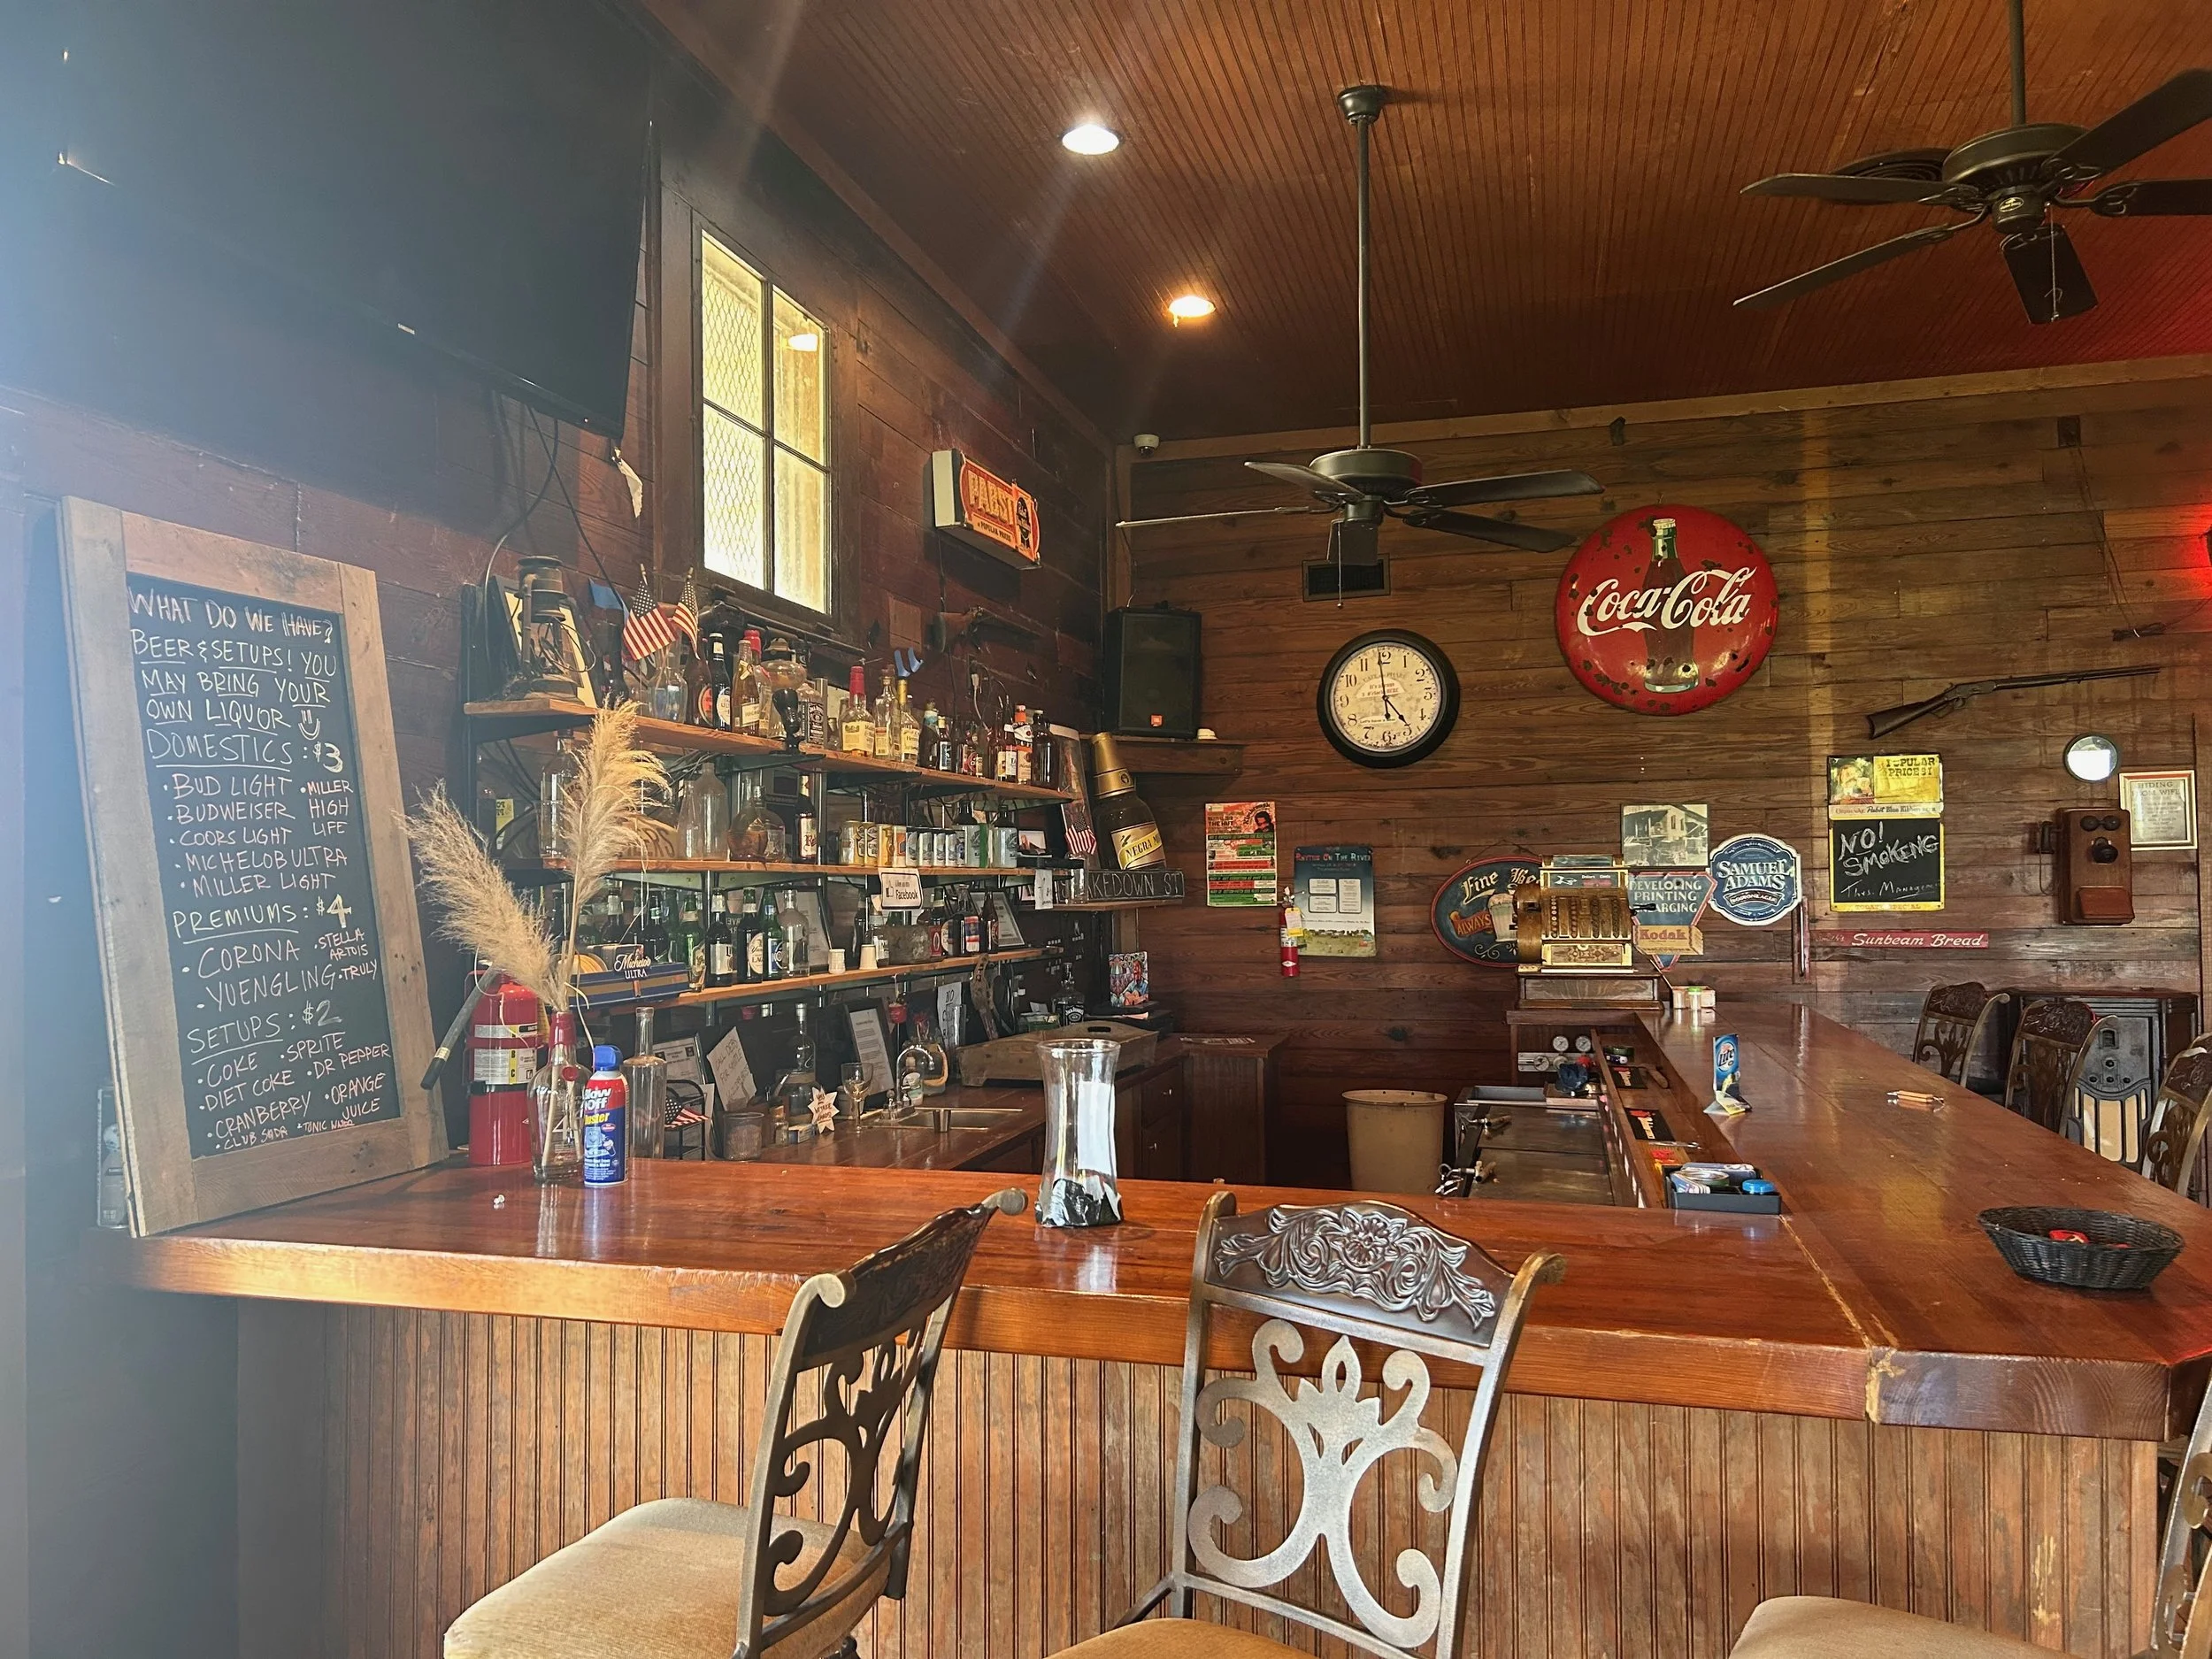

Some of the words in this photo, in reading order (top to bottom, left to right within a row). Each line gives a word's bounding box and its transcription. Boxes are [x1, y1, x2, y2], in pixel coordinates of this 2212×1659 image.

[1577, 566, 1757, 636] Coca-Cola
[128, 585, 197, 623] WHAT
[205, 599, 235, 629] DO
[245, 606, 273, 633] WE
[282, 611, 334, 644] HAVE?
[131, 629, 193, 658] BEER
[211, 641, 292, 672] SETUPS!
[301, 651, 337, 677] YOU
[142, 670, 187, 696] MAY
[197, 672, 259, 698] BRING
[274, 680, 331, 704] YOUR
[147, 699, 193, 722] OWN
[205, 699, 292, 731] LIQUOR
[173, 773, 221, 799] BUD
[231, 774, 292, 797] LIGHT
[307, 780, 353, 795] MILLER
[176, 802, 296, 824] BUDWEISER
[309, 797, 349, 818] HIGH
[180, 830, 235, 846] COORS
[243, 827, 292, 845] LIGHT
[313, 821, 348, 836] LIFE
[1125, 839, 1153, 861] NEGRA
[1839, 821, 1885, 861] NO!
[186, 850, 288, 873] MICHELOB
[291, 846, 347, 867] ULTRA
[1842, 834, 1940, 877] SMOKING
[1717, 858, 1790, 879] SAMUEL
[193, 874, 271, 898] MILLER
[280, 872, 336, 890] LIGHT
[895, 889, 918, 900] Facebook
[1062, 872, 1155, 898] KEDOWN
[1461, 871, 1500, 905] Fine
[1724, 875, 1786, 893] ADAMS
[1633, 902, 1697, 913] ARGING
[1634, 891, 1697, 902] PRINTING
[1457, 912, 1493, 936] ALWAYS
[1640, 929, 1687, 940] Kodak
[319, 928, 365, 950] STELLA
[1852, 933, 1924, 947] Sunbeam
[1931, 933, 1985, 948] Bread
[197, 940, 300, 979] CORONA
[329, 944, 368, 961] ARTOIS
[341, 959, 378, 979] TRULY
[624, 968, 648, 979] ULTRA
[205, 965, 336, 1012] YUENGLING
[287, 1031, 346, 1063] SPRITE
[1718, 1049, 1734, 1066] Lite
[206, 1052, 258, 1087] COKE
[312, 1060, 335, 1079] DR
[339, 1043, 391, 1071] PEPPER
[204, 1082, 247, 1112] DIET
[252, 1070, 295, 1096] COKE
[330, 1072, 386, 1104] ORANGE
[215, 1091, 311, 1139] CRANBERRY
[342, 1098, 380, 1121] JUICE
[584, 1112, 610, 1125] uster
[302, 1120, 327, 1133] TONIC
[224, 1132, 257, 1149] CLUB
